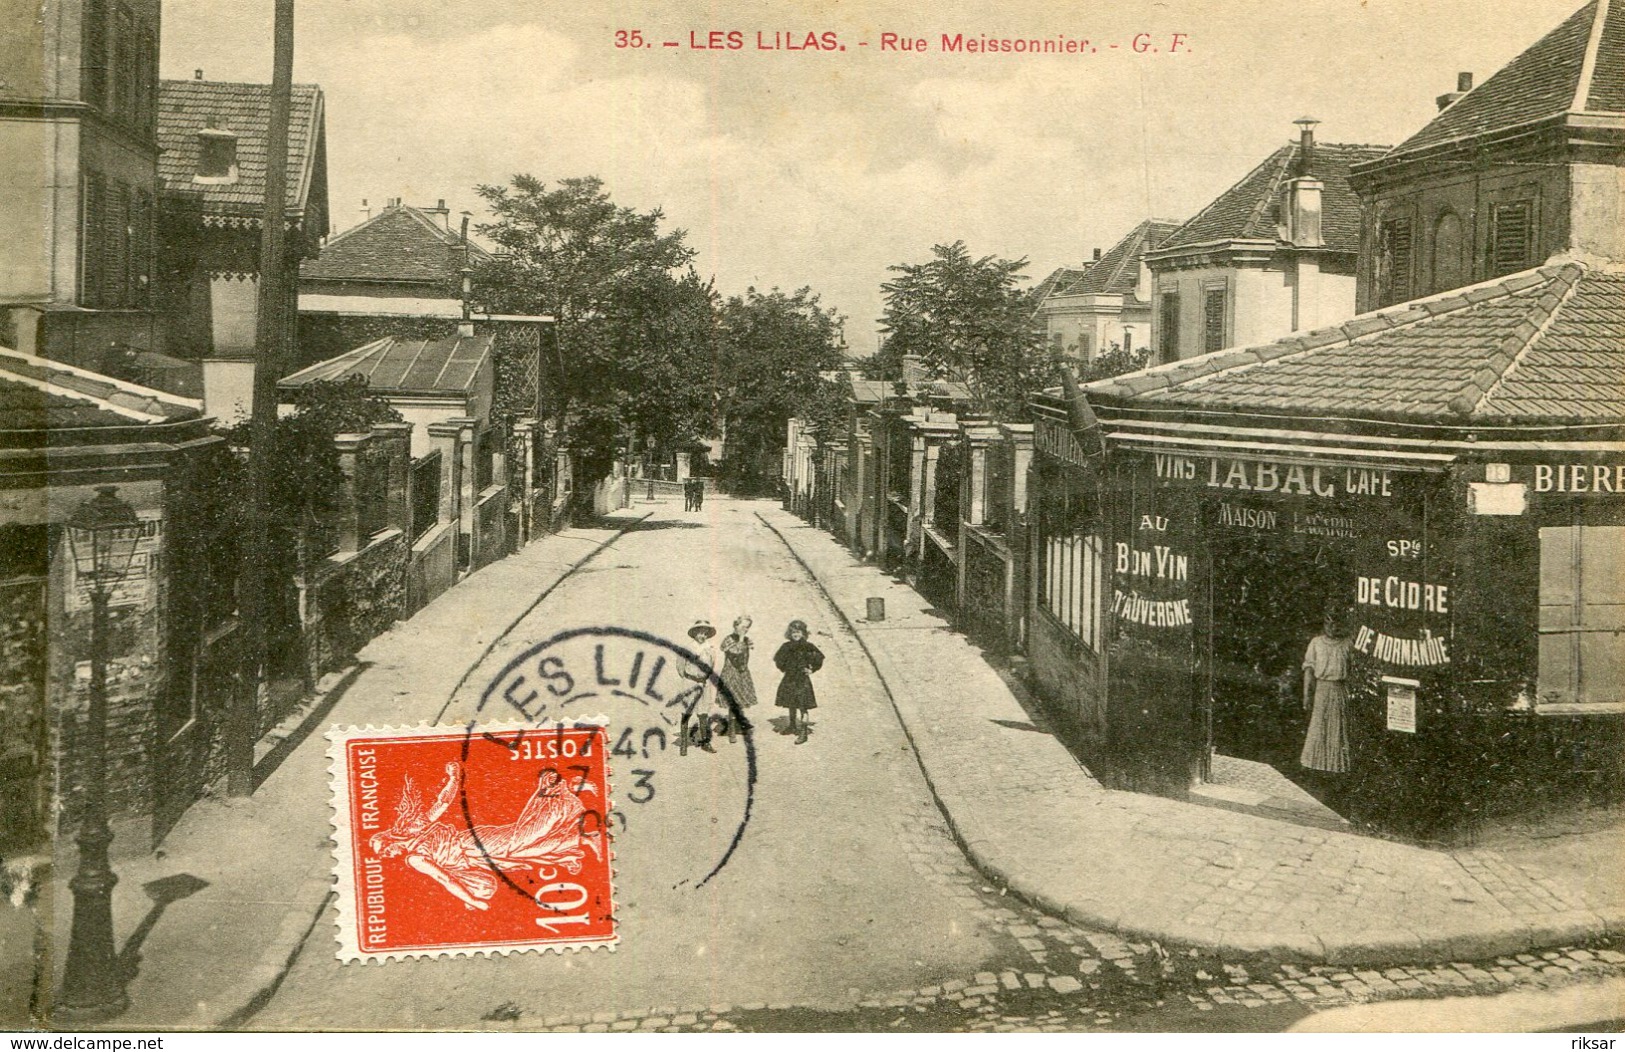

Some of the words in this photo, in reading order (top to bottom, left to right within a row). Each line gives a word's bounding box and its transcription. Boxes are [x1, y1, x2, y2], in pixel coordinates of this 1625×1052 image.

[1155, 453, 1195, 480] VINS
[1206, 457, 1335, 498] TABAC
[1139, 515, 1169, 531] AU
[1218, 502, 1277, 530] MAISON
[1153, 545, 1188, 582] VIN
[1357, 576, 1381, 606] DE
[1384, 575, 1448, 614] CIDRE
[1354, 624, 1375, 654] DE
[1373, 630, 1450, 667] NORMANDIE
[483, 656, 575, 751] LES
[594, 643, 728, 748] LILAS
[510, 739, 593, 761] POSTES
[357, 747, 380, 830] FRANÇAISE
[627, 768, 656, 805] 3
